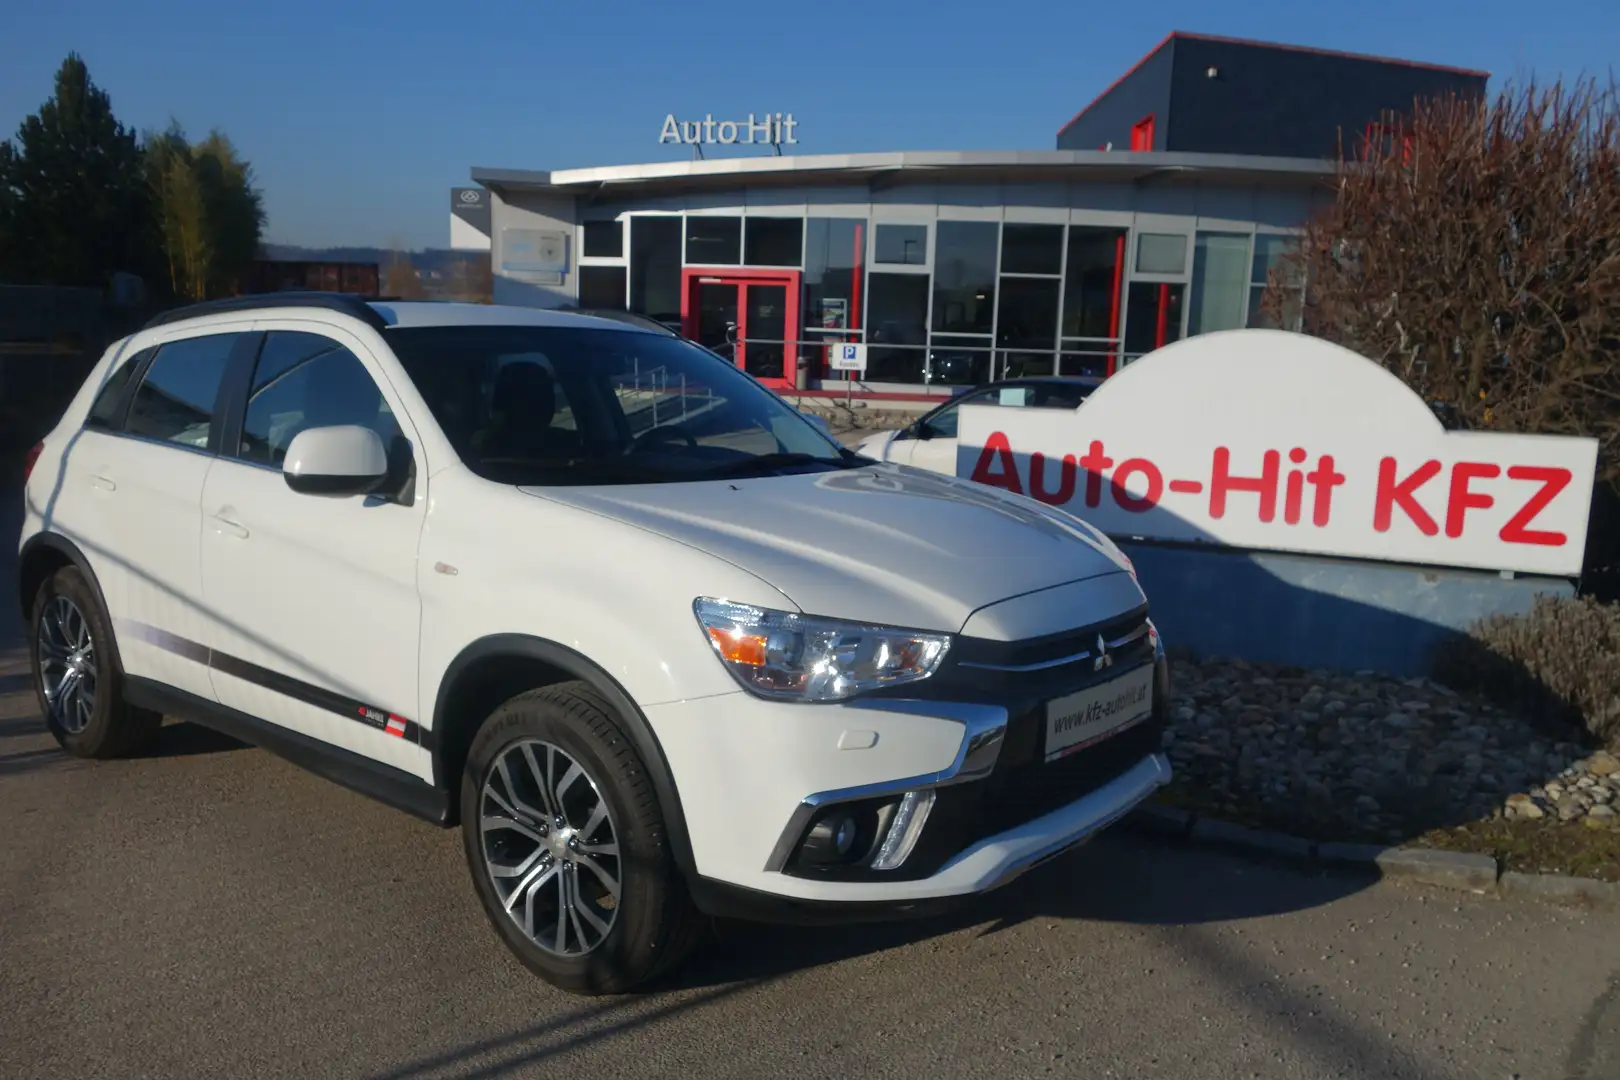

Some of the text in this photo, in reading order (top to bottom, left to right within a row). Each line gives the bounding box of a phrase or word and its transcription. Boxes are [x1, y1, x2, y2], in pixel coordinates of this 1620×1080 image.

[659, 112, 798, 144] Auto Hit
[844, 346, 855, 359] P
[969, 431, 1573, 547] Auto-Hit KFZ
